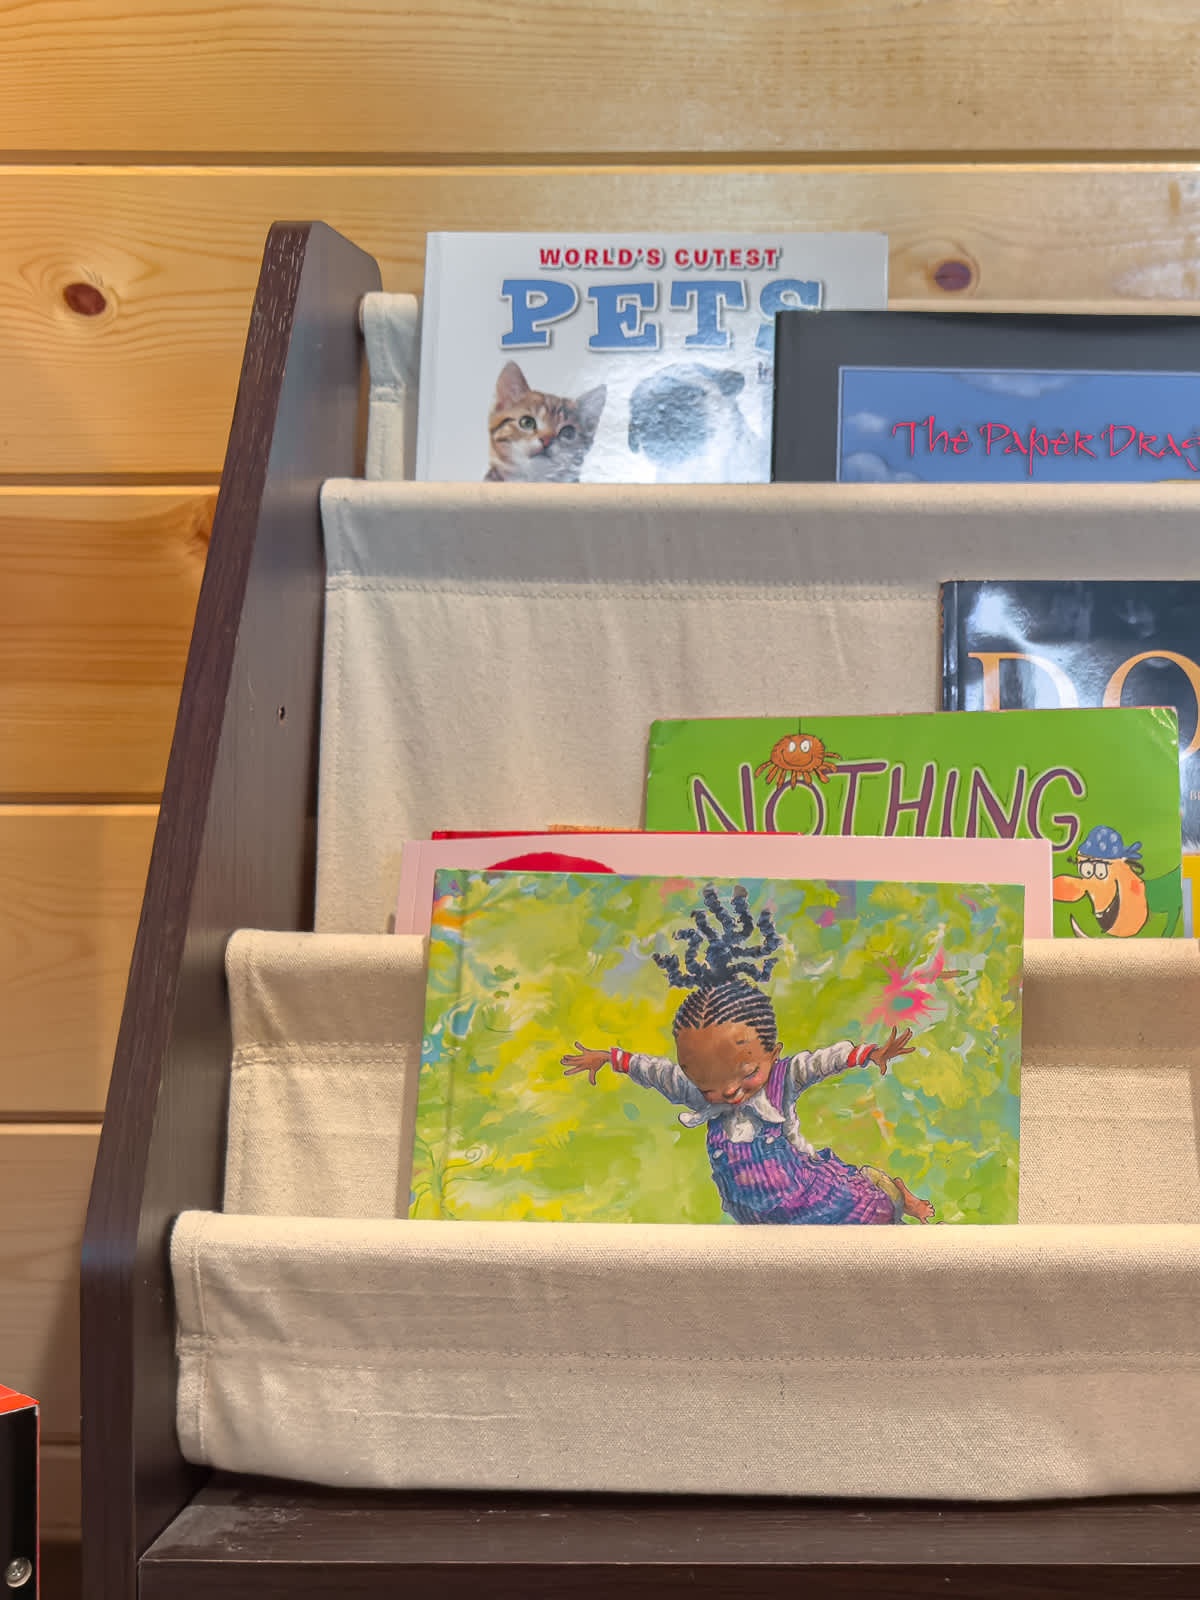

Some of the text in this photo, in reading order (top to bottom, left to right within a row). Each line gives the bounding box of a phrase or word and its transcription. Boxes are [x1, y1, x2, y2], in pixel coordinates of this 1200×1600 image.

[539, 248, 779, 268] WORLD'S CUTEST
[500, 278, 823, 350] PETS
[892, 415, 969, 458] The
[979, 422, 1096, 476] Paper
[692, 761, 1085, 852] NOTHING
